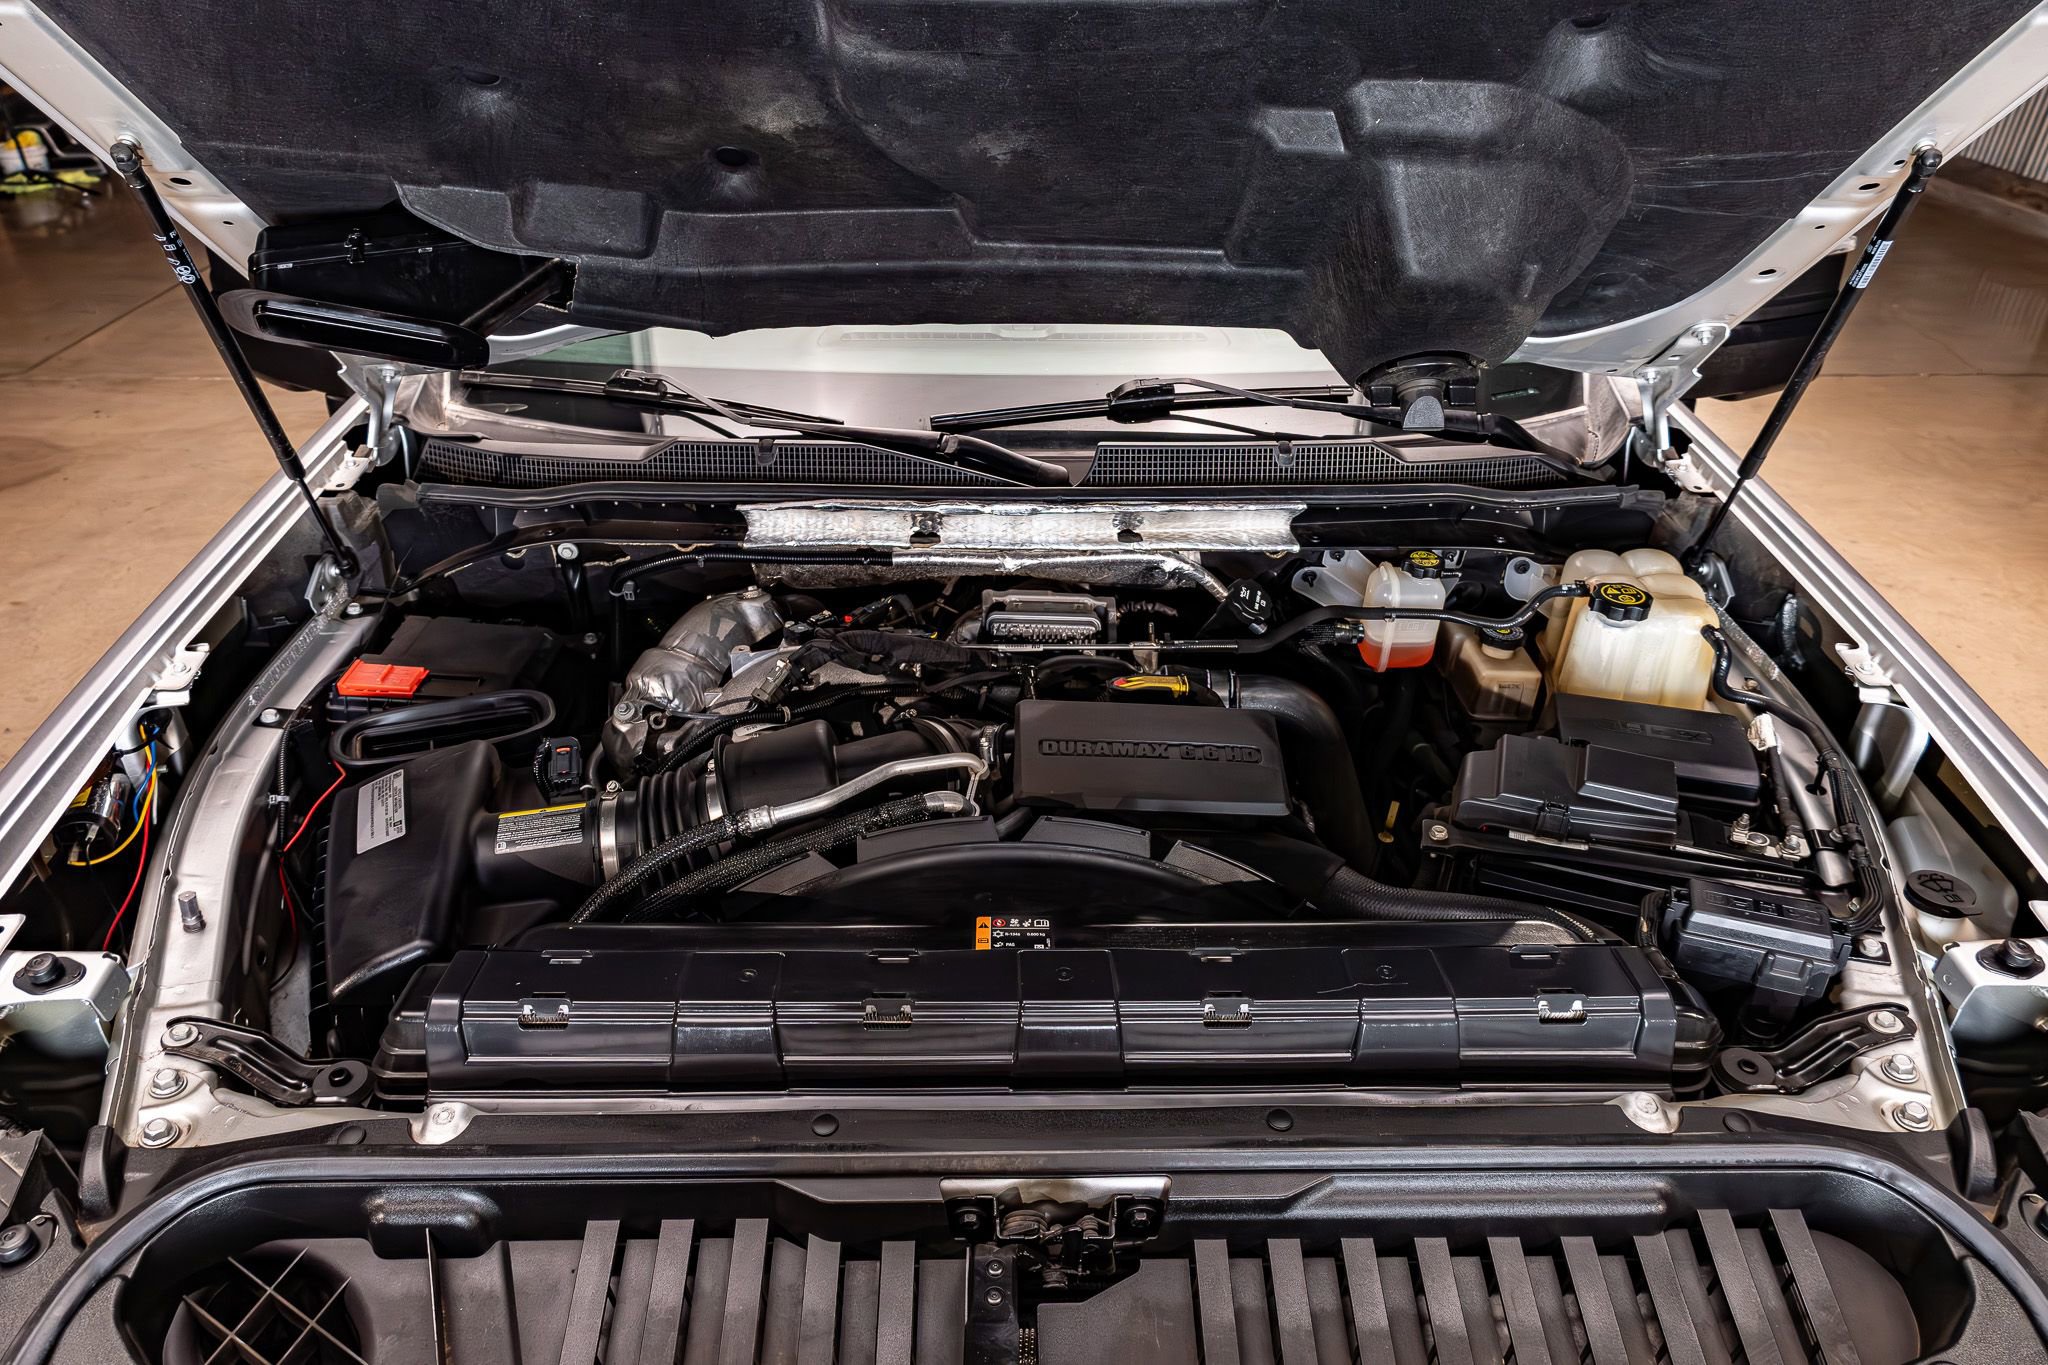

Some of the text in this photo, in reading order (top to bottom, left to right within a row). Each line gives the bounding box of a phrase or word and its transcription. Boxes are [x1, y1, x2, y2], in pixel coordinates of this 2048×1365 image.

[1041, 740, 1261, 763] DURAMAX 6.6 HD
